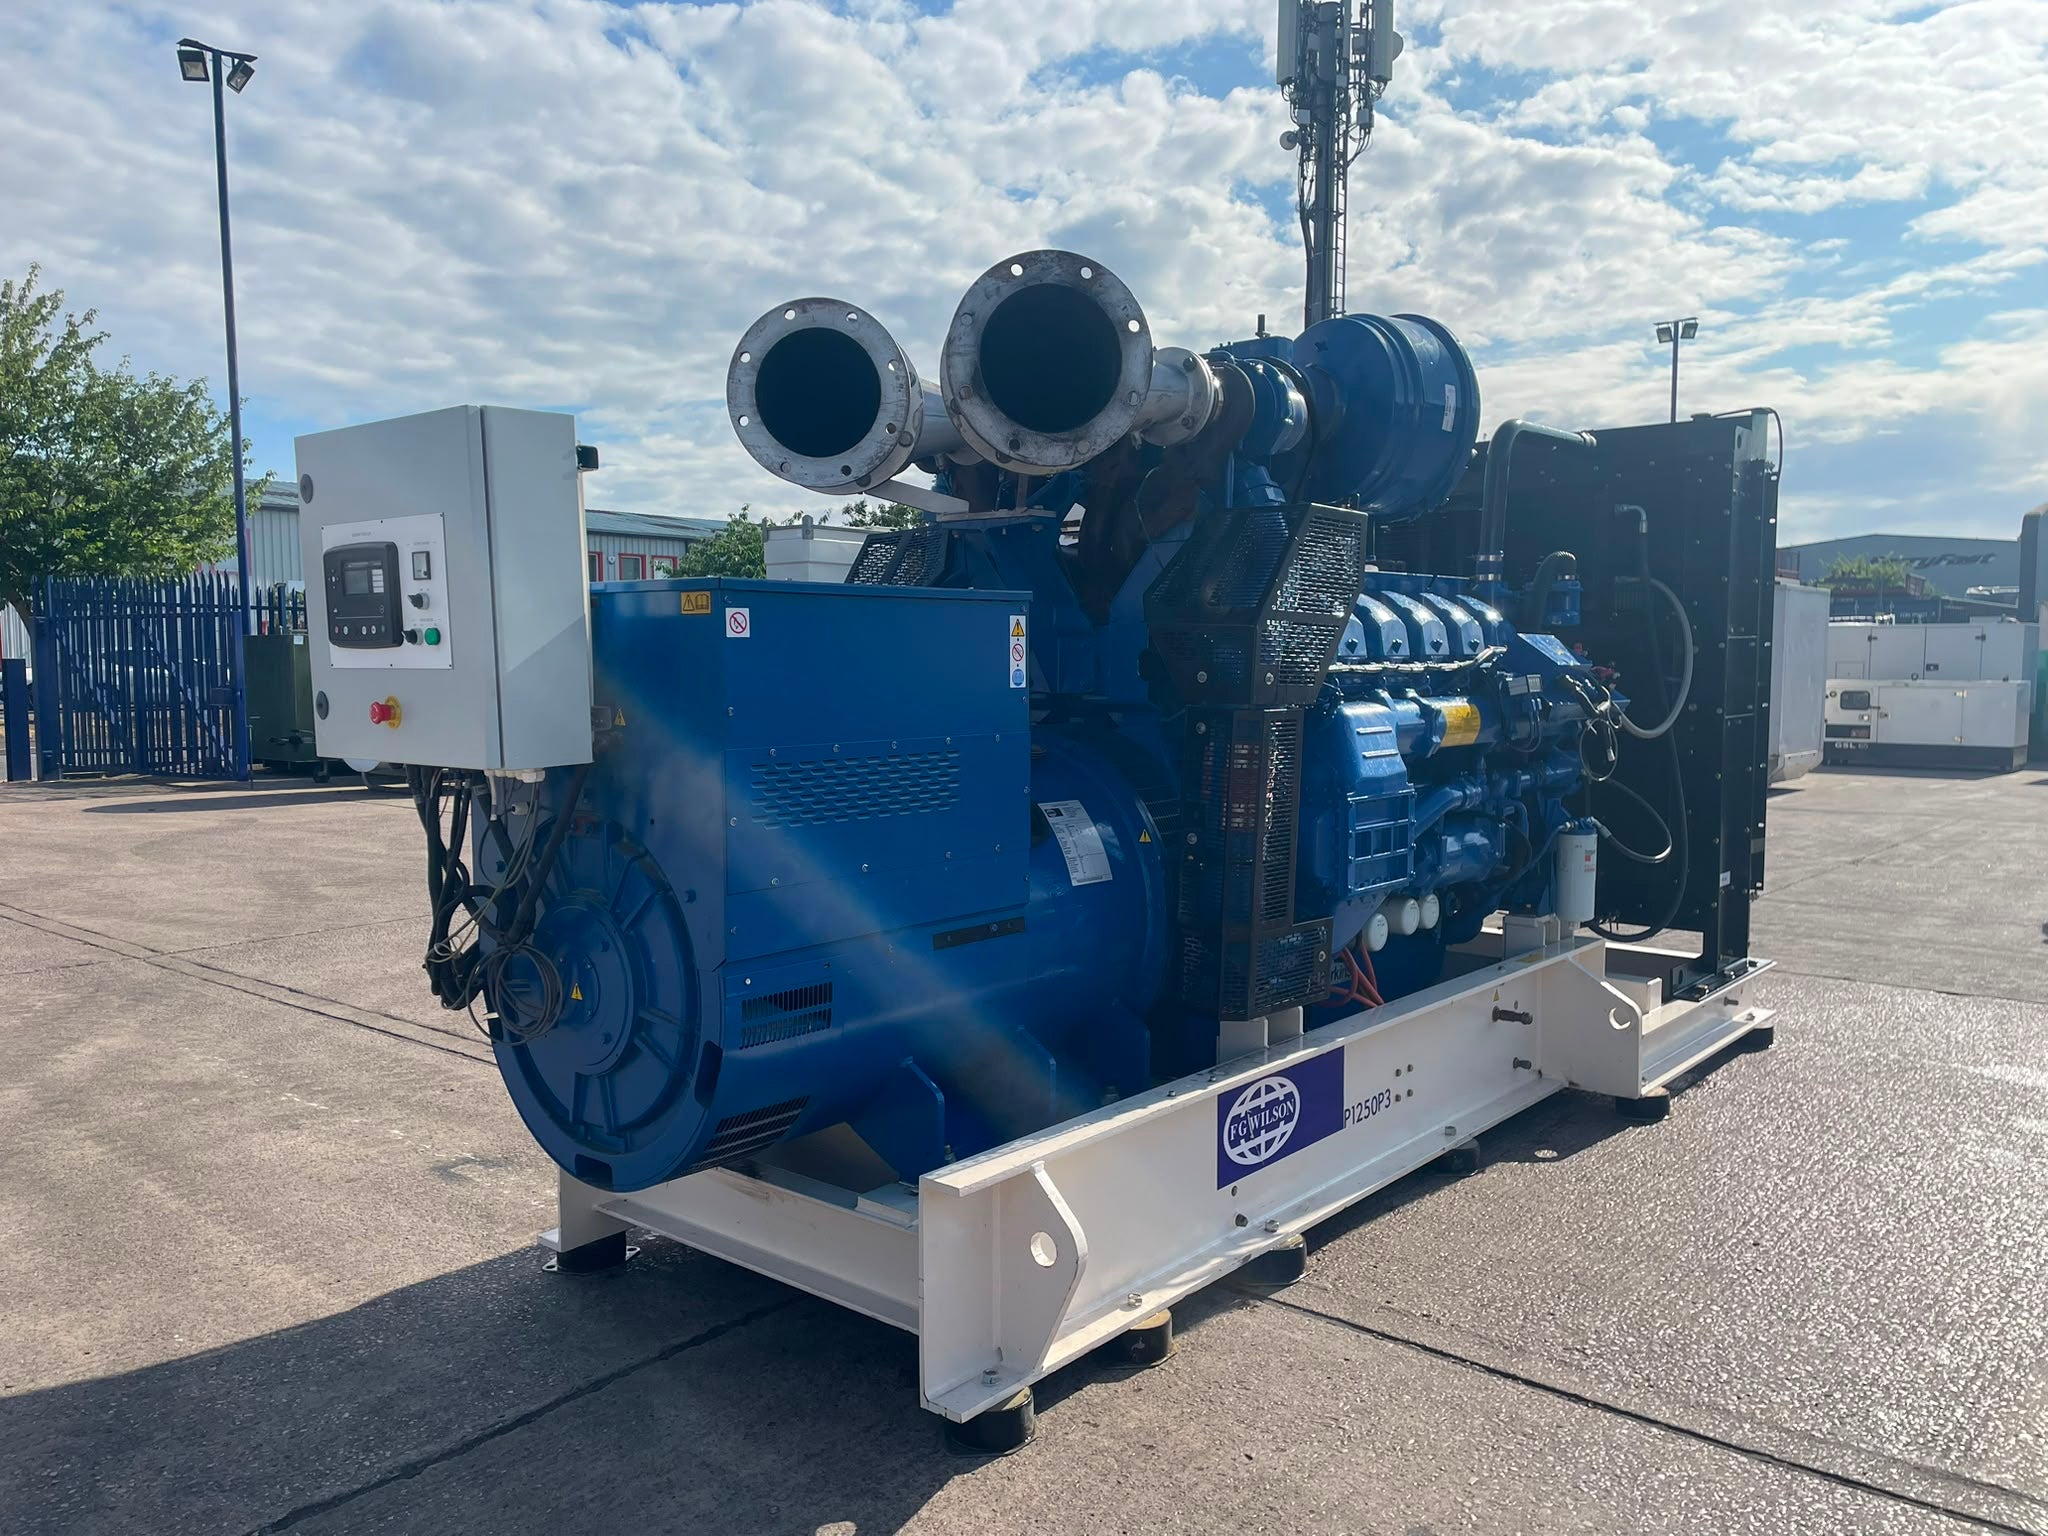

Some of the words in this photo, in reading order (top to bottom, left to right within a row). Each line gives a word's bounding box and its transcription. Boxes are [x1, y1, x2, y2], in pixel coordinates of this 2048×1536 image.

[1230, 1120, 1248, 1141] FG
[1249, 1098, 1295, 1130] WILSON
[1344, 1088, 1391, 1127] P1250P3
